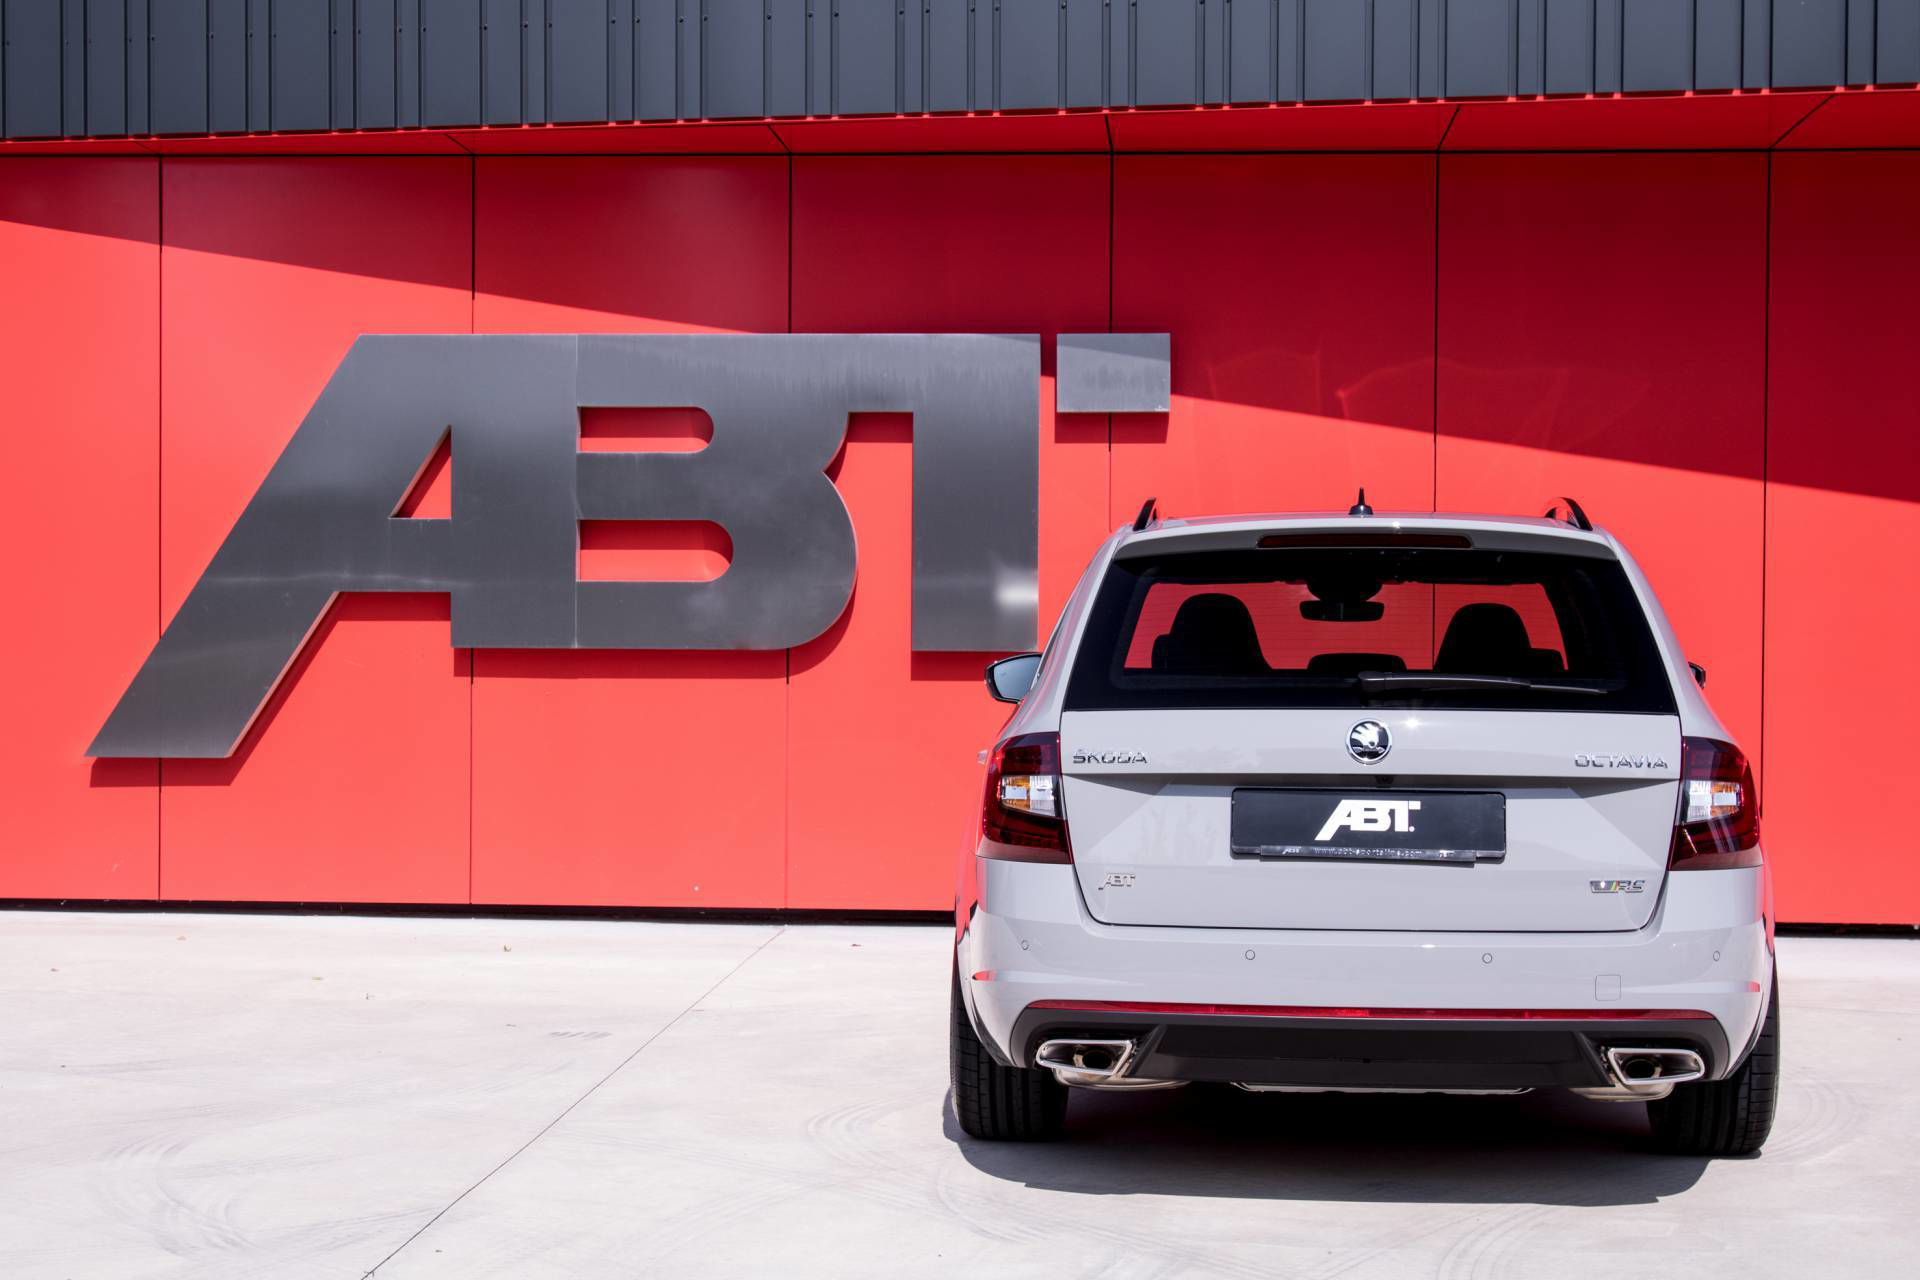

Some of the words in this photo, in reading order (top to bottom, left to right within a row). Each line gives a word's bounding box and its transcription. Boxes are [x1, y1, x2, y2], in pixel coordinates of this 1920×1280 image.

[86, 333, 1172, 759] ABT
[1574, 752, 1668, 768] OCTAVIA
[1097, 873, 1136, 891] ABT
